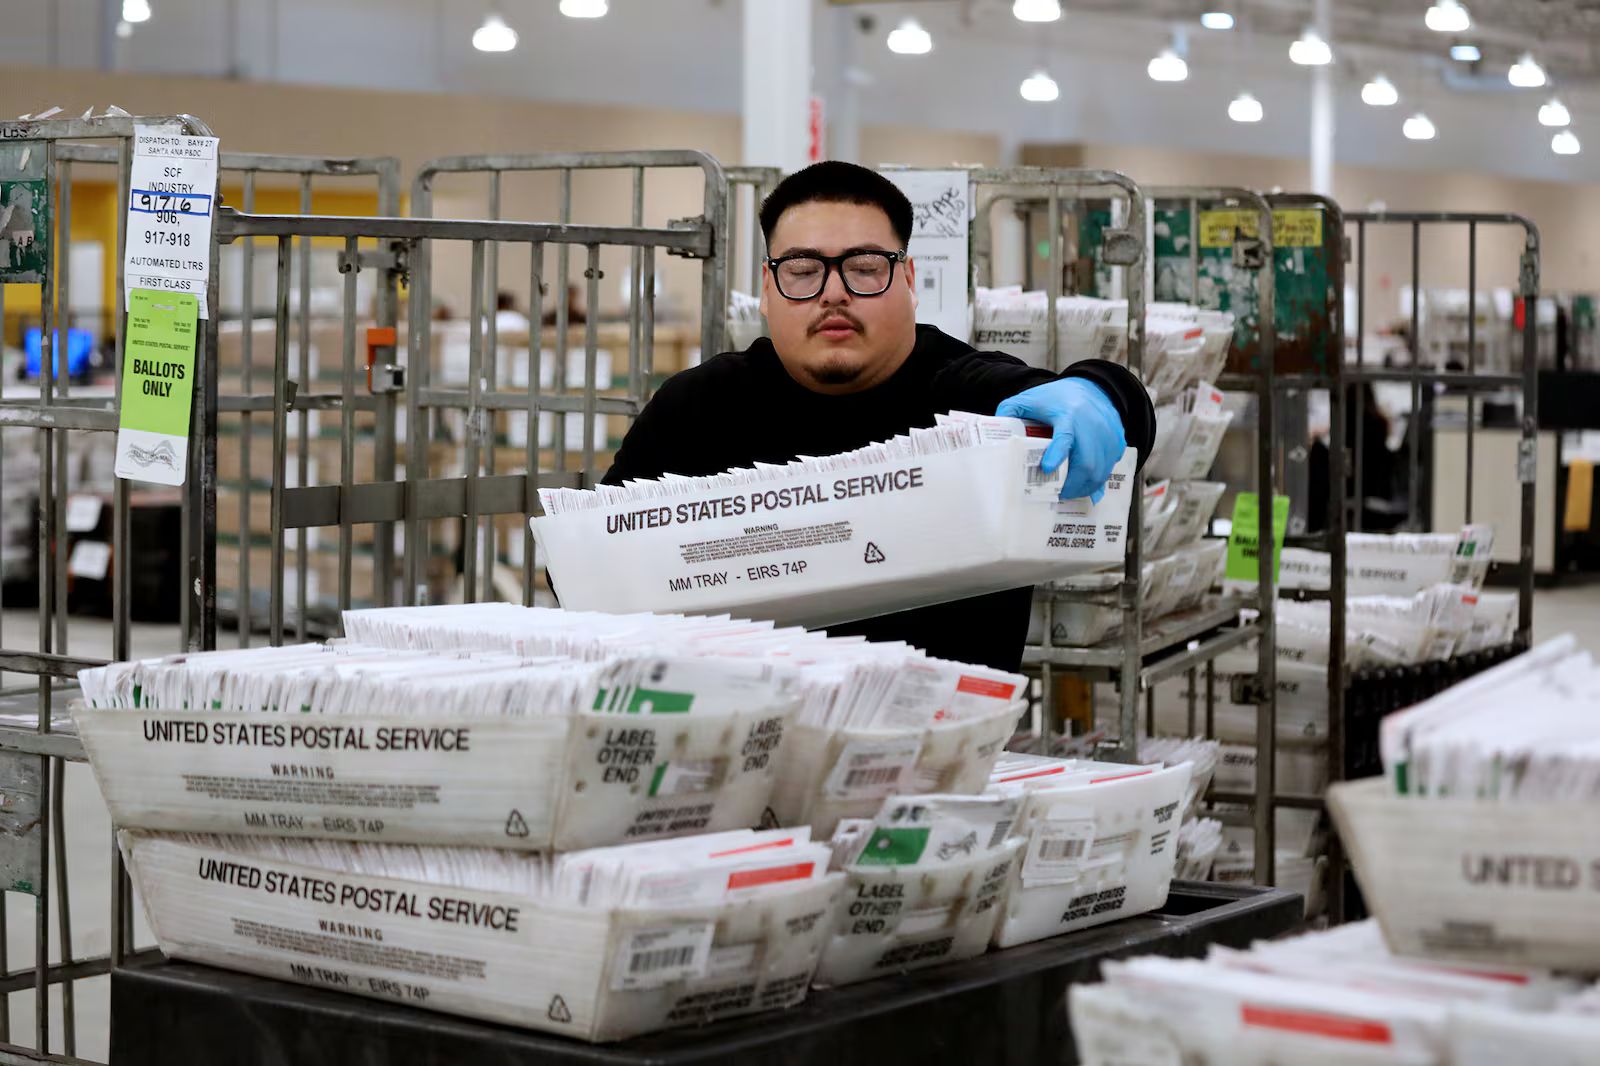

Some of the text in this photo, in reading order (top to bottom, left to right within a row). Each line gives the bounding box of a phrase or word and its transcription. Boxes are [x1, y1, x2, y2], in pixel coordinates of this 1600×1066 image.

[139, 136, 170, 145] DISPATCH
[170, 138, 182, 146] TO:
[148, 147, 202, 157] SANTA ANA P&DC
[163, 167, 183, 178] SCF
[148, 182, 195, 194] INDUSTRY
[144, 230, 191, 247] 917-918
[130, 256, 204, 271] AUTOMATED LTRS
[139, 277, 191, 290] FIRST CLASS
[975, 330, 1032, 344] ERVICE
[133, 359, 186, 380] BALLOTS
[142, 379, 173, 398] ONLY
[606, 467, 923, 535] UNITED STATES POSTAL SERVICE
[743, 523, 779, 535] WARNING
[669, 577, 693, 592] MM
[694, 571, 729, 588] TRAY
[747, 564, 780, 581] EIRS
[781, 560, 808, 576] 74P
[143, 719, 470, 752] UNITED STATES POSTAL SERVICE
[749, 716, 785, 738] LABEL
[605, 729, 659, 747] LABEL
[596, 748, 656, 765] OTHER
[743, 753, 770, 773] END
[270, 763, 336, 779] WARNING
[602, 766, 641, 784] END
[244, 812, 268, 827] MM
[269, 813, 305, 830] TRAY
[322, 816, 357, 833] EIRS
[358, 818, 385, 834] 74P
[1461, 852, 1581, 890] UNITED
[198, 857, 521, 932] UNITED STATES POSTAL SERVICE
[857, 883, 905, 898] LABEL
[849, 901, 902, 917] OTHER
[318, 918, 385, 942] WARNING
[852, 919, 885, 935] END
[314, 967, 349, 985] TRAY
[368, 977, 402, 997] EIRS
[404, 983, 430, 1000] 74P
